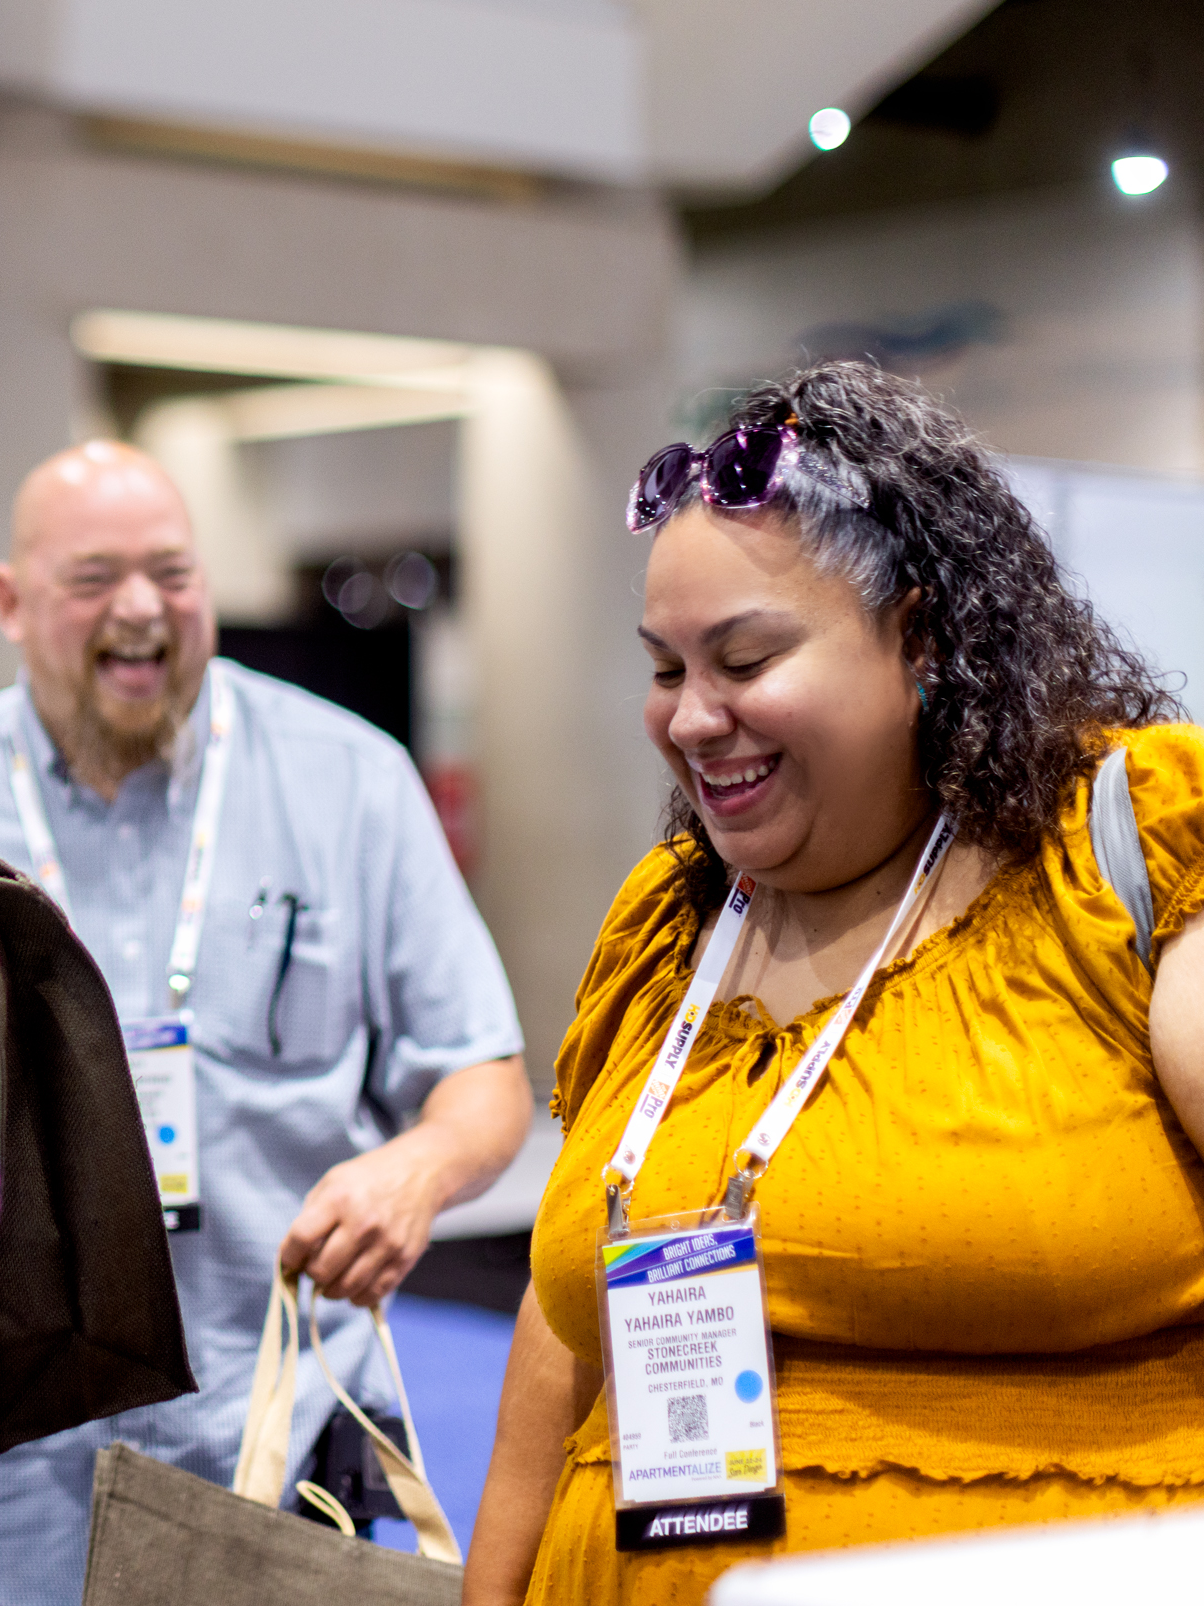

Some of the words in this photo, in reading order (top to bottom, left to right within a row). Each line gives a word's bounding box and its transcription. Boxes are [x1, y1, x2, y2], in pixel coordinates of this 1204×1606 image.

[733, 890, 751, 915] Pro
[844, 986, 863, 1009] Pro
[644, 1096, 664, 1119] Pro
[662, 1240, 691, 1260] BRIGHT
[647, 1260, 684, 1283] BRILLIANT
[685, 1245, 736, 1271] CONNECTIONS
[648, 1286, 706, 1306] YAHAIRA
[624, 1312, 683, 1333] YAHAIRA
[687, 1306, 735, 1325] YAMBO
[628, 1338, 654, 1349] SENIOR
[656, 1333, 699, 1346] COMMUNITY
[701, 1328, 737, 1340] MANAGER
[648, 1341, 718, 1360] STONECREEK
[645, 1355, 722, 1375] COMMUNITIES
[648, 1379, 708, 1394] CHESTERFIELD,
[711, 1376, 724, 1386] MO
[663, 1450, 677, 1460] Full
[679, 1447, 717, 1459] Conference
[629, 1461, 722, 1481] APARTMENTALIZE
[649, 1510, 748, 1537] ATTENDEE
